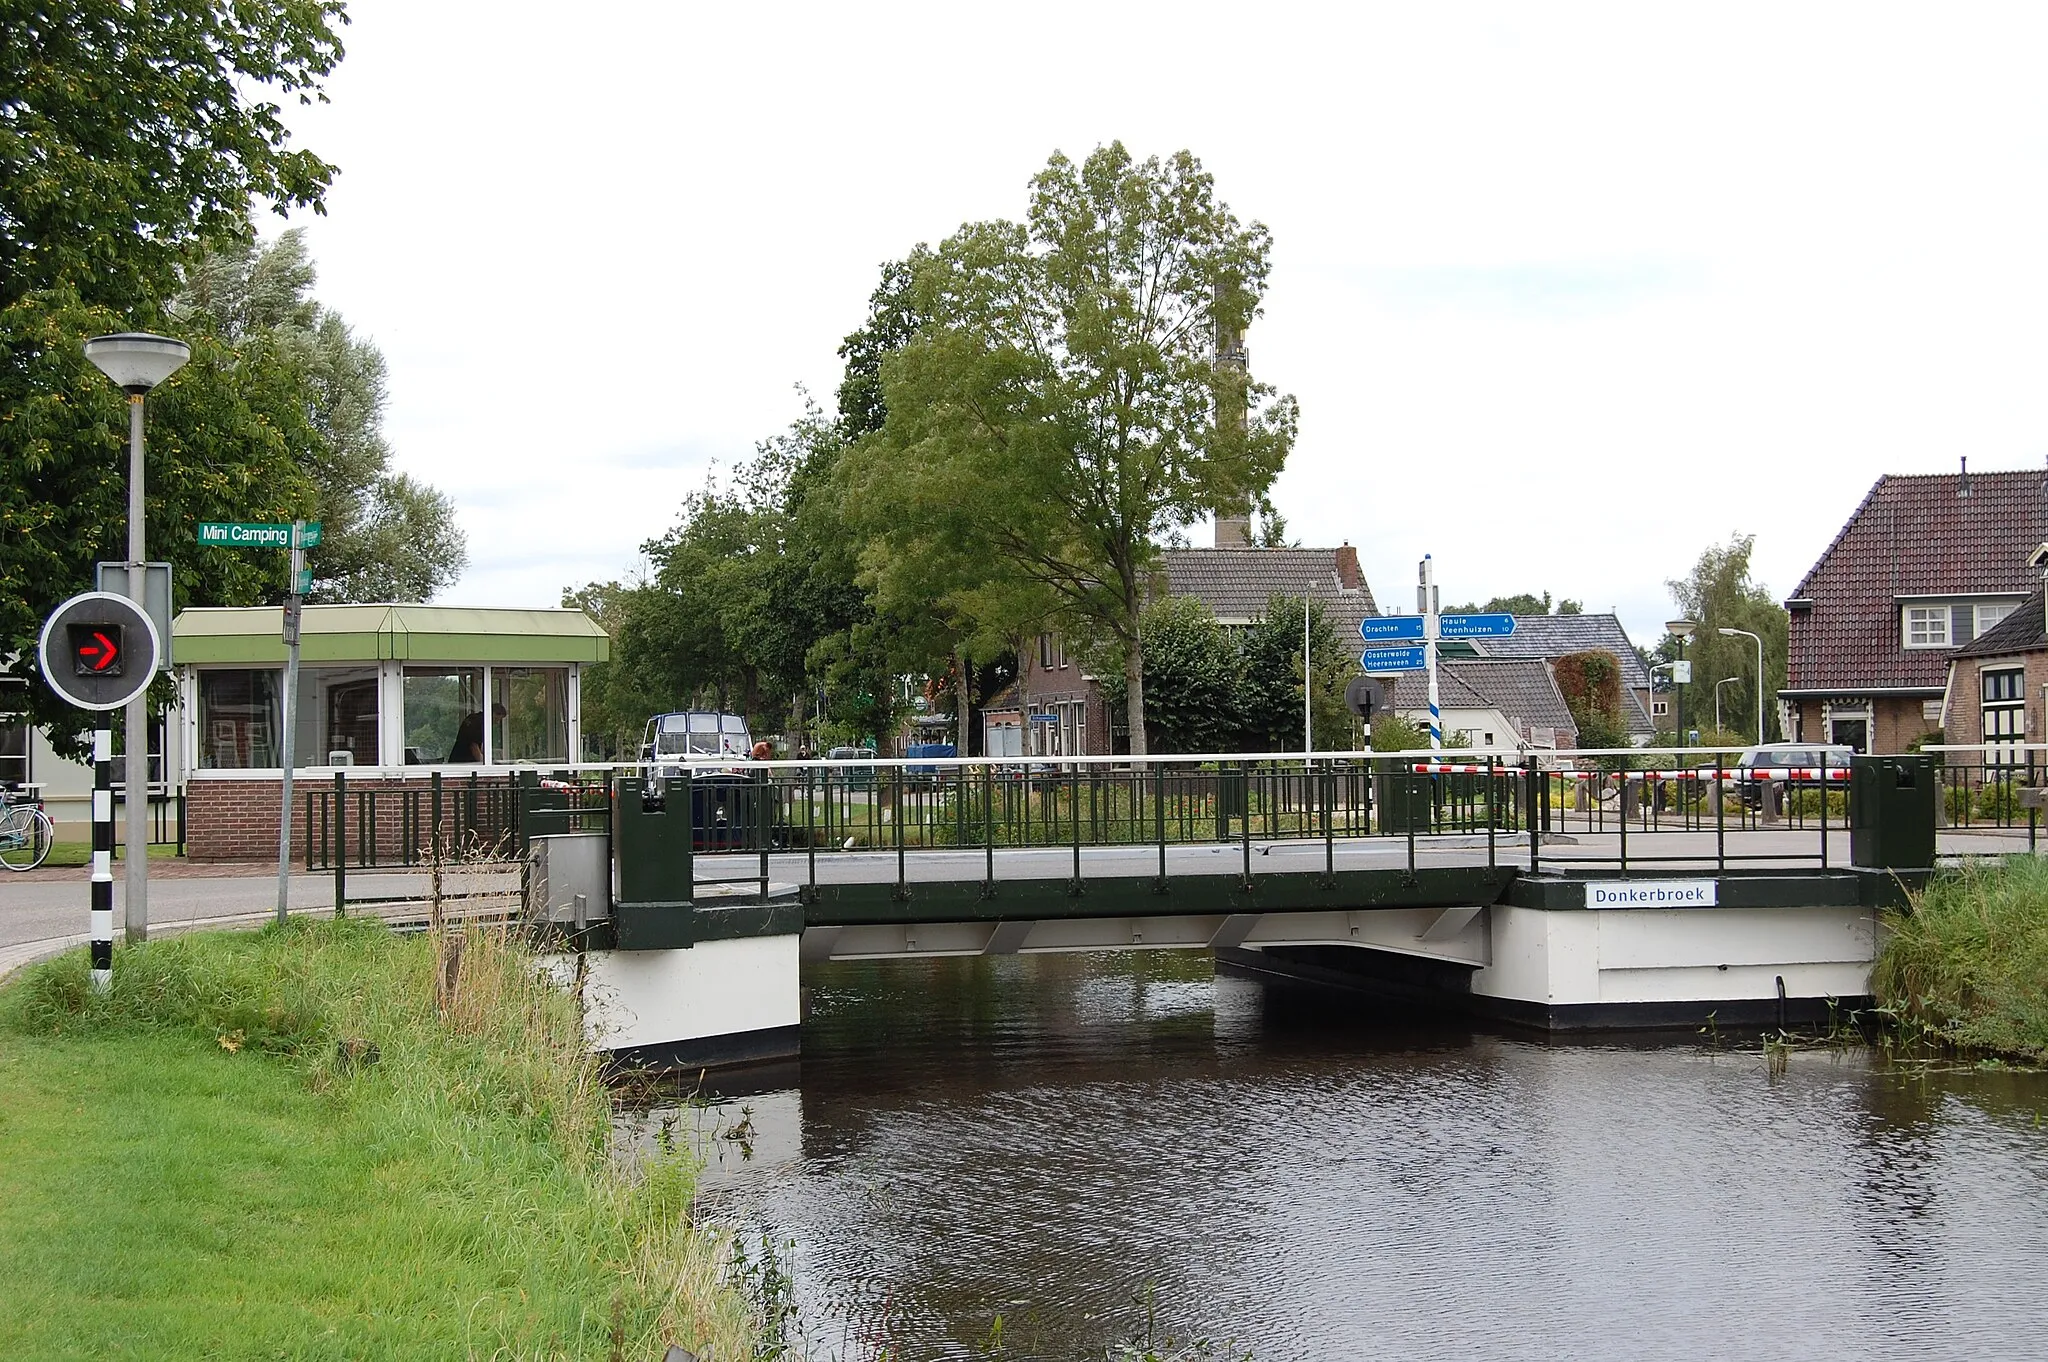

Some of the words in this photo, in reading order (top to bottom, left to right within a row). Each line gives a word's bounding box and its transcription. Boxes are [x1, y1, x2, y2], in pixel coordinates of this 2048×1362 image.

[203, 525, 228, 540] Mini
[231, 525, 288, 544] Camping
[1596, 887, 1704, 902] Donkerbroek
